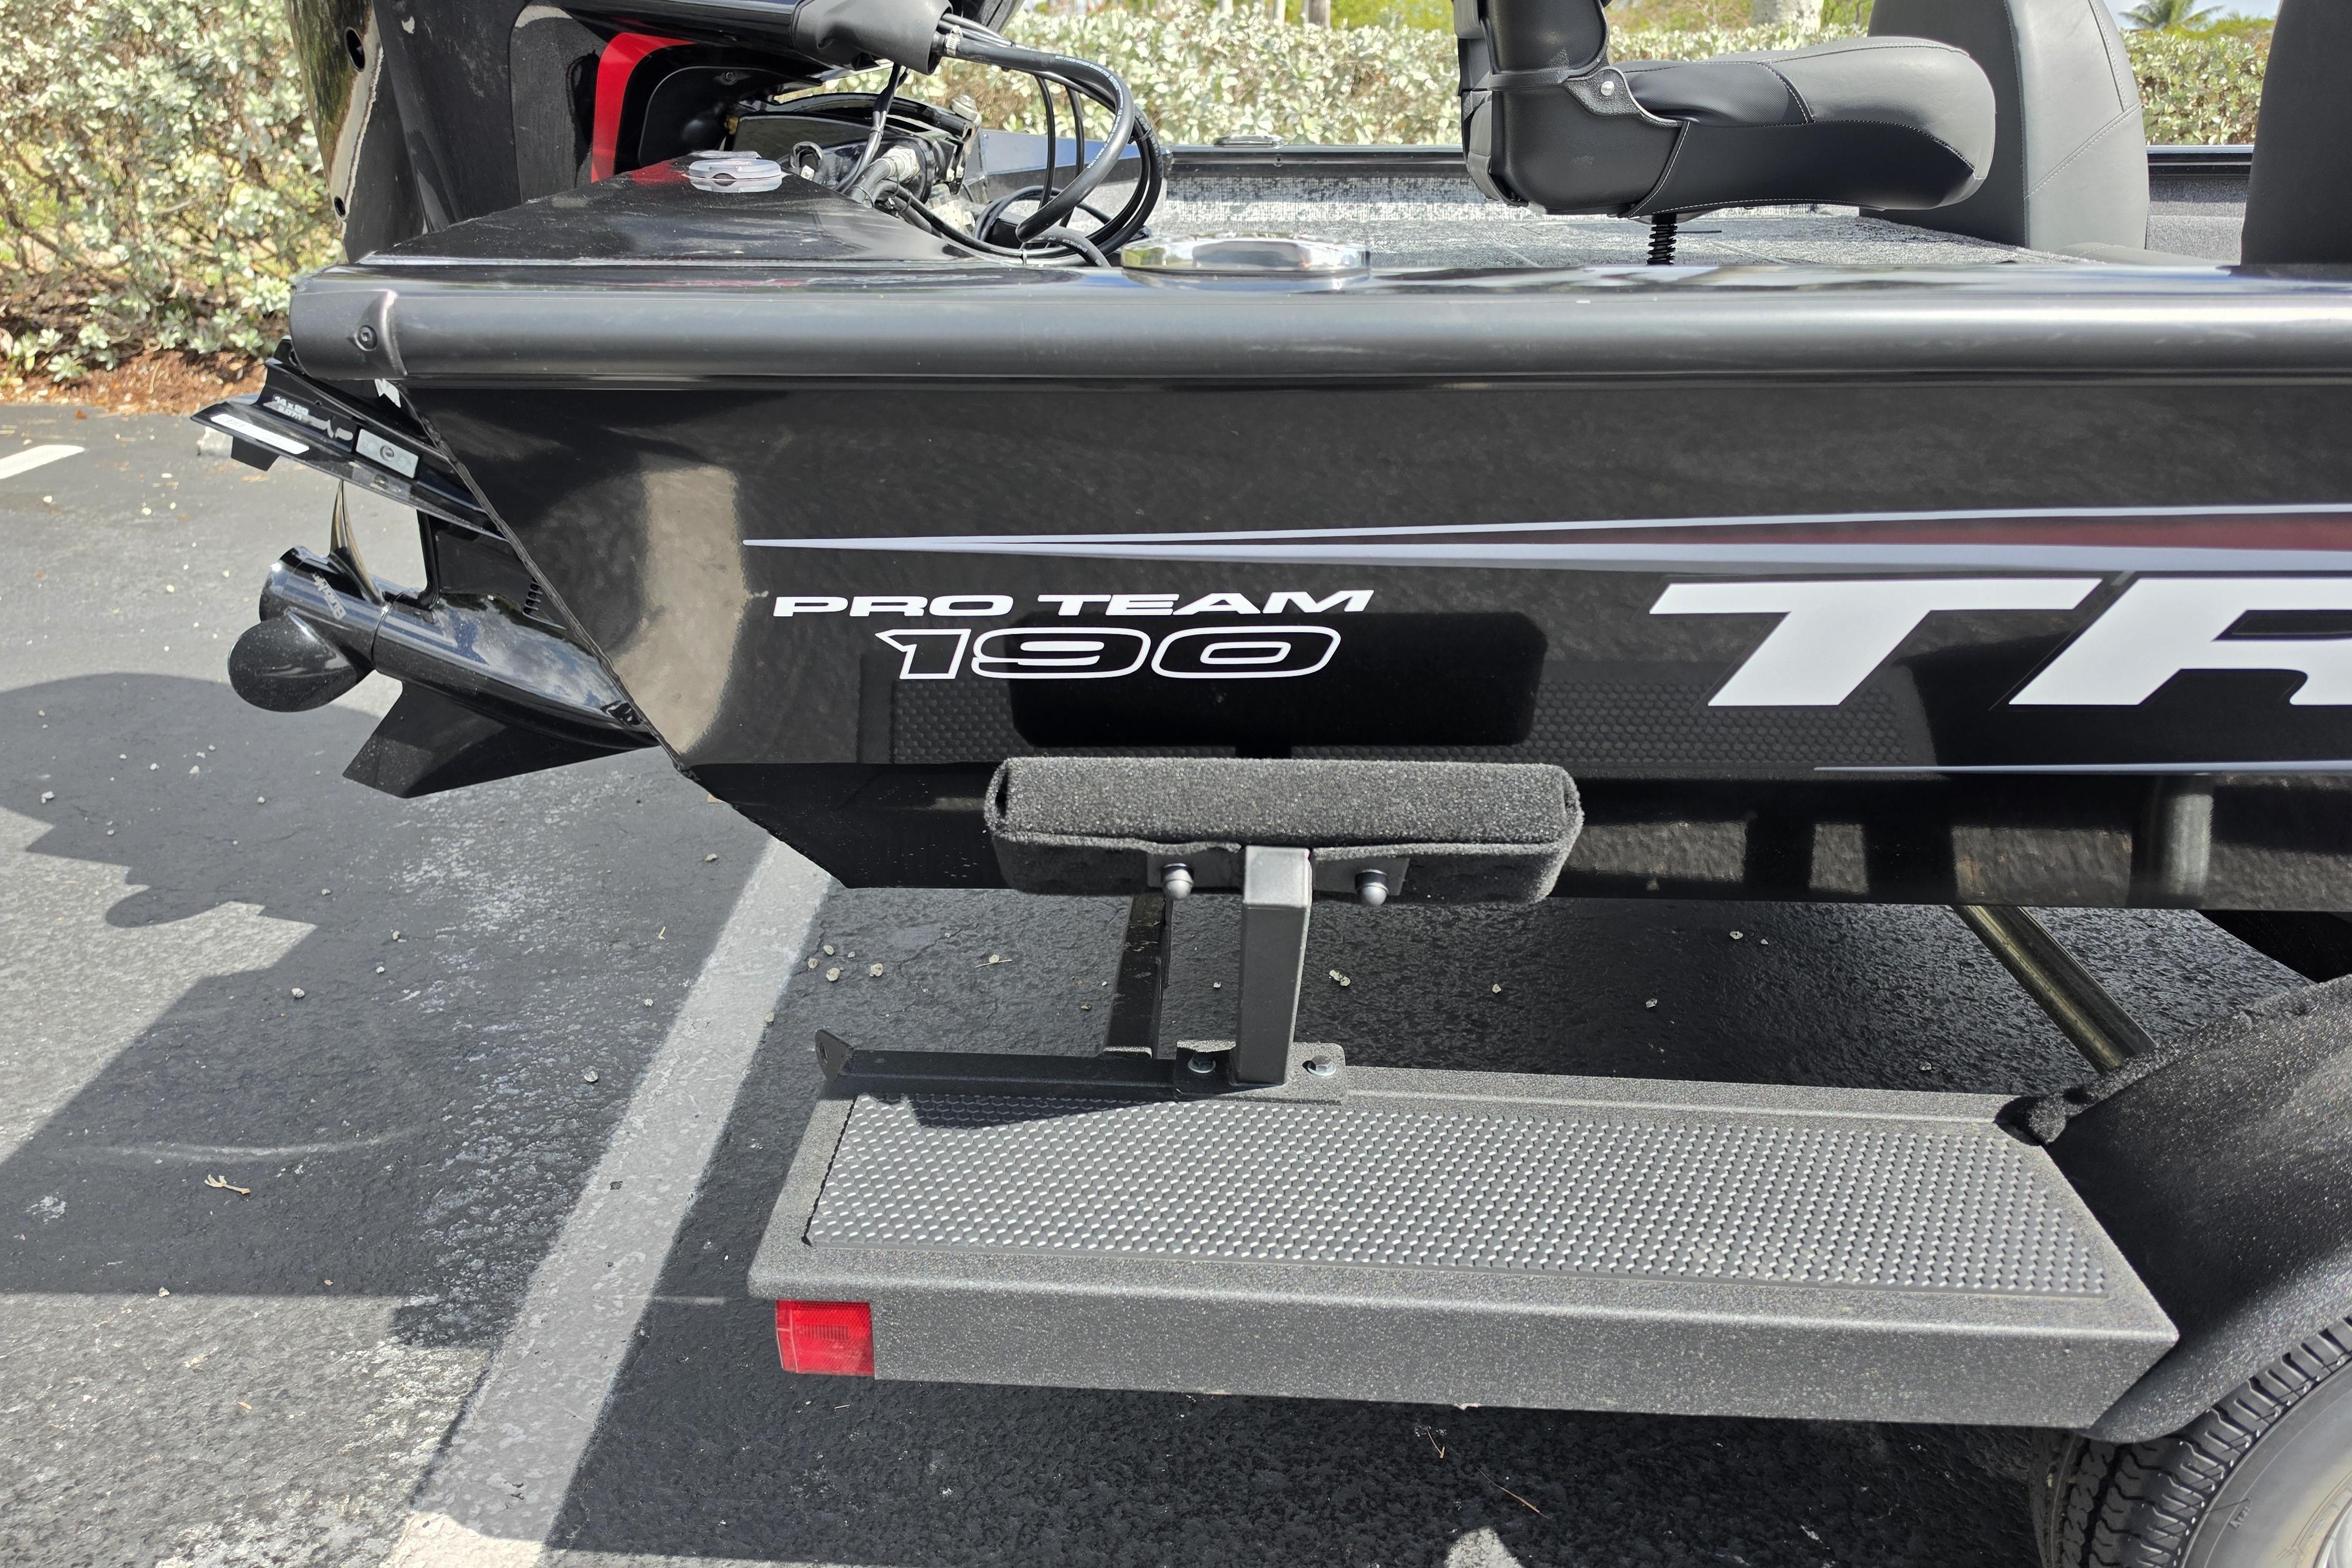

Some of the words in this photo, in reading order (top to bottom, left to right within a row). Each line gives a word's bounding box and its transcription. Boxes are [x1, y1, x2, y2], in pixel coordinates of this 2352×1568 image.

[773, 594, 1014, 617] PRO
[1037, 589, 1375, 616] TEAM
[874, 625, 1342, 680] 190
